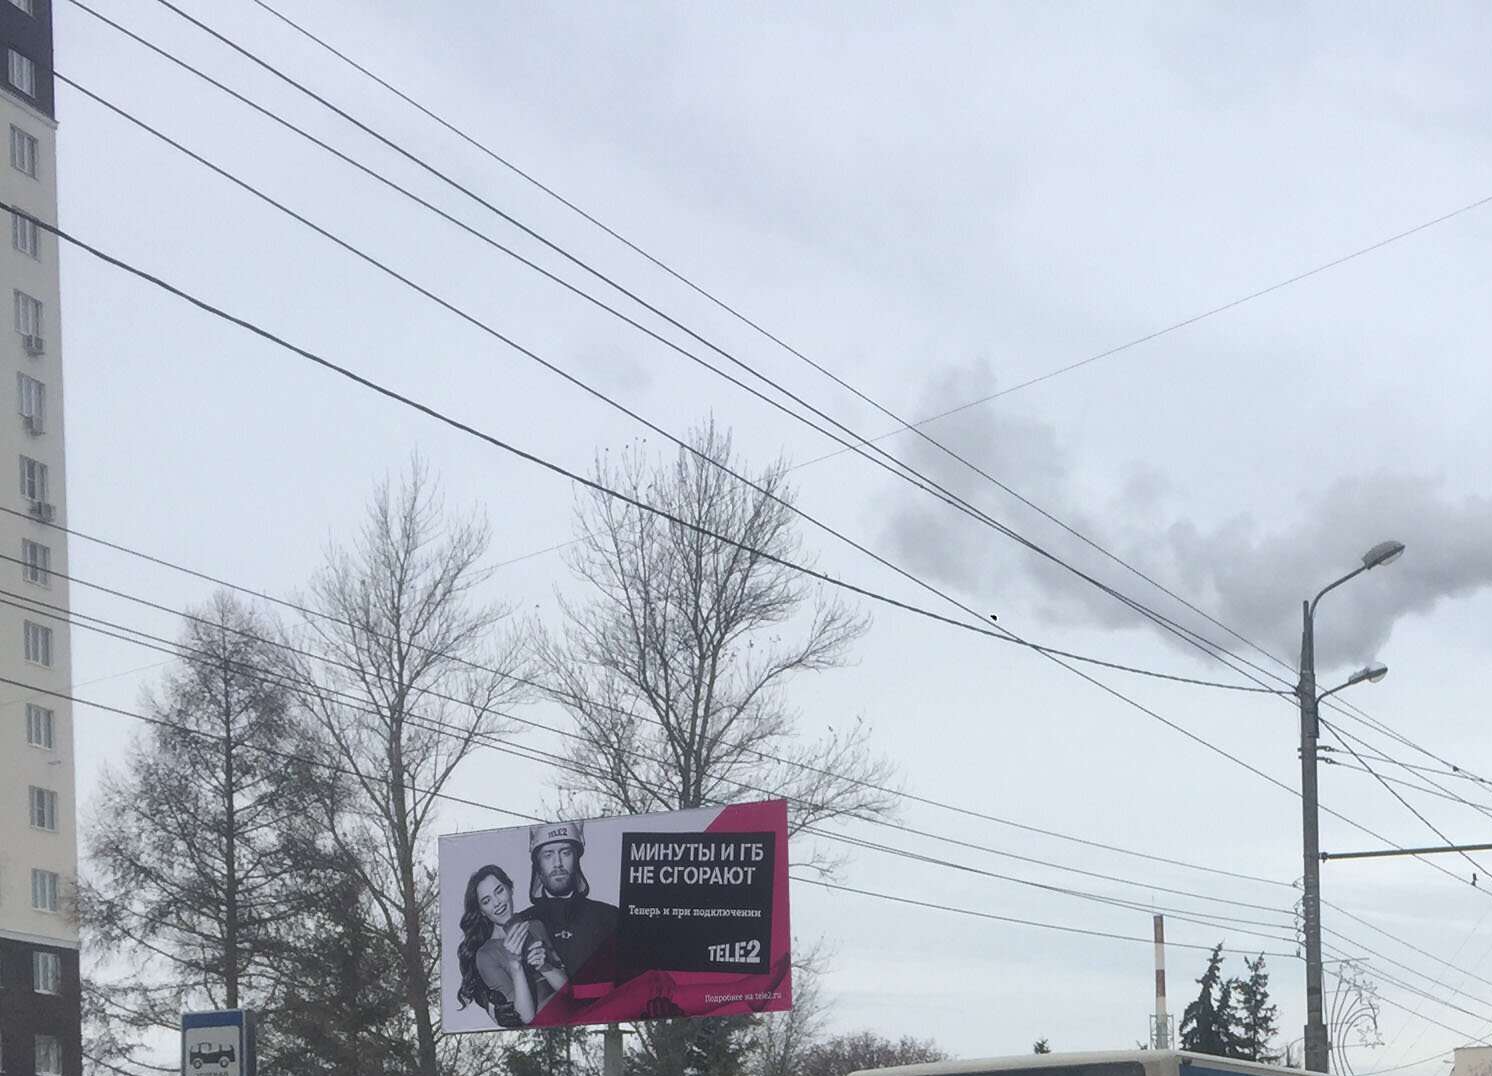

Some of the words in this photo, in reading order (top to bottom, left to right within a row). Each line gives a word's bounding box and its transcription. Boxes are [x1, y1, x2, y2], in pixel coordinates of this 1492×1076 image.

[630, 842, 716, 862] МИНУТЫ
[720, 843, 735, 861] И
[740, 843, 764, 861] ГБ
[629, 866, 655, 884] НЕ
[659, 866, 756, 885] СГОРАЮТ
[628, 904, 661, 918] Теперь
[672, 909, 691, 919] при
[692, 909, 762, 918] подключении
[708, 939, 761, 964] TELE2
